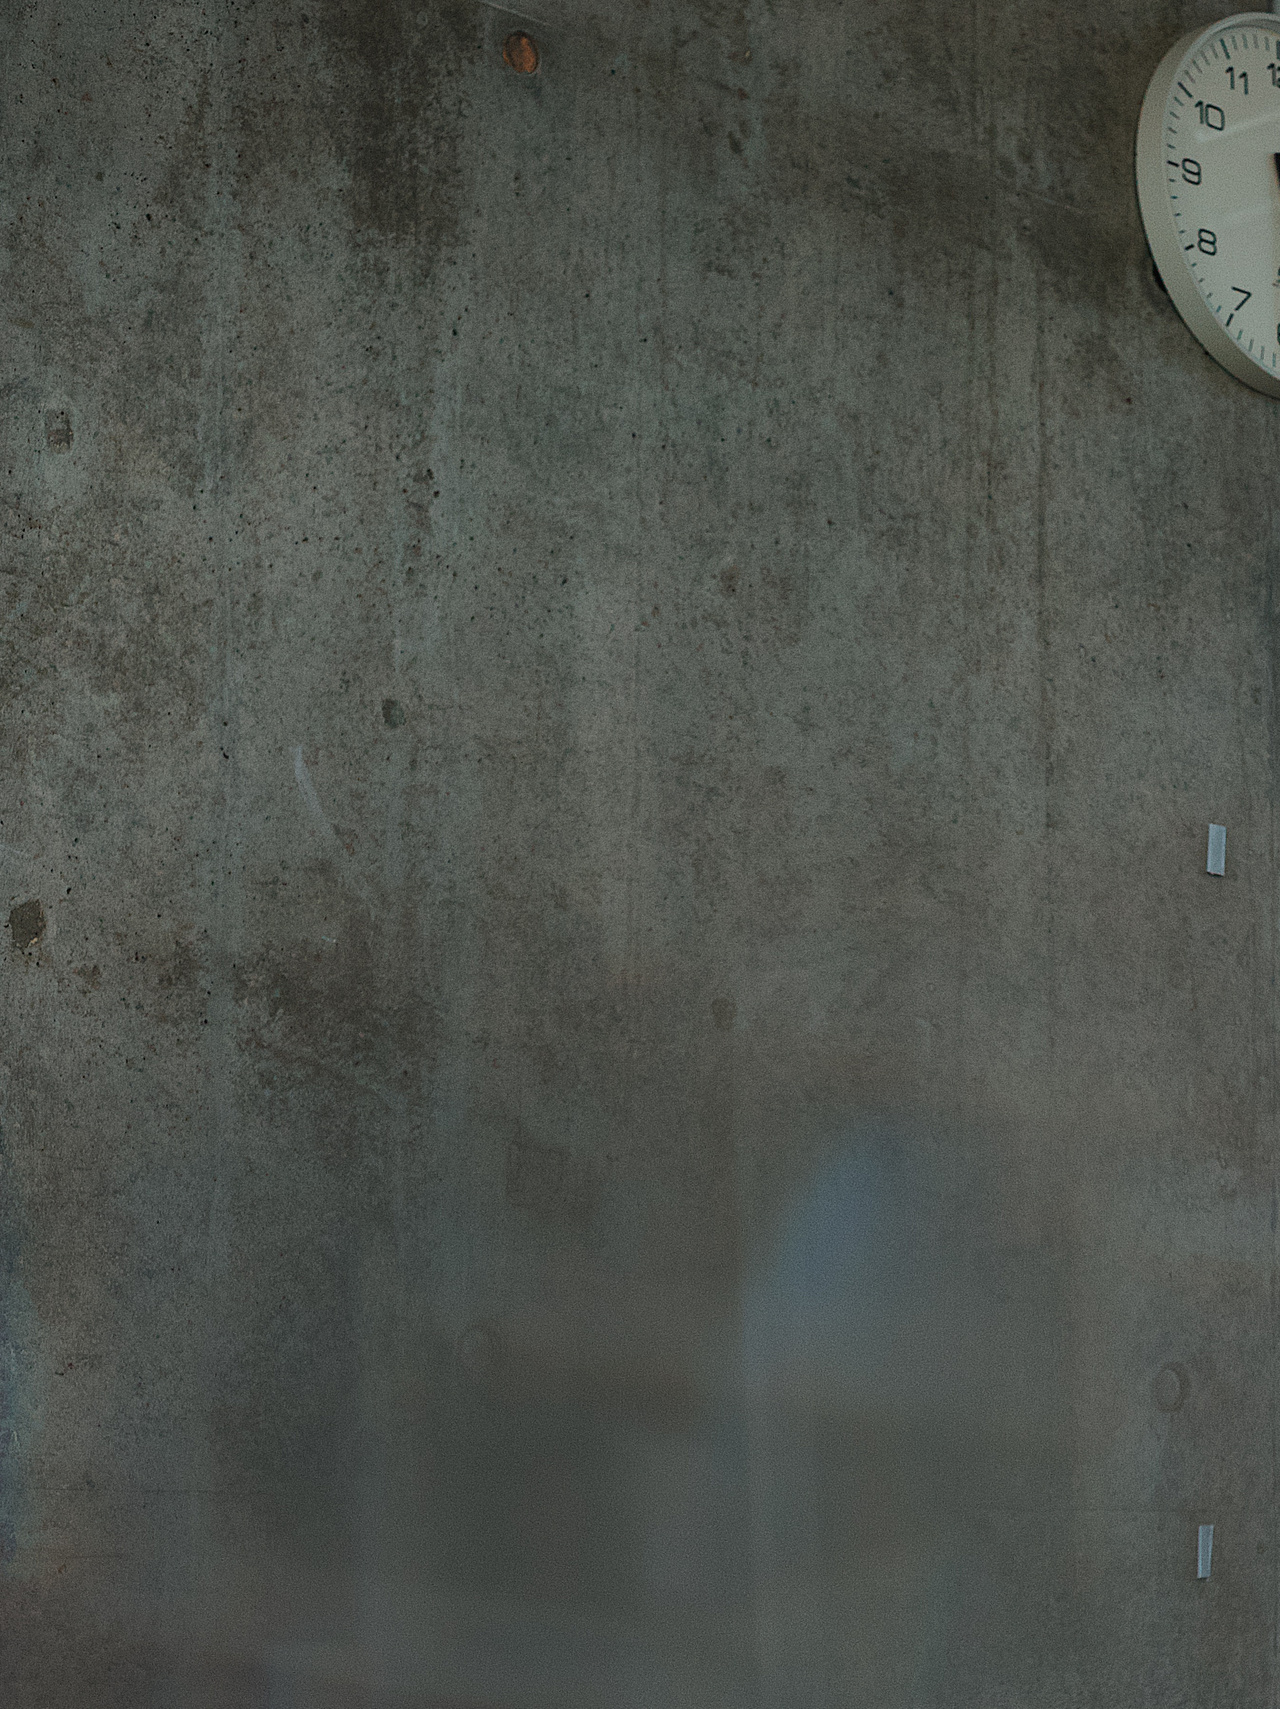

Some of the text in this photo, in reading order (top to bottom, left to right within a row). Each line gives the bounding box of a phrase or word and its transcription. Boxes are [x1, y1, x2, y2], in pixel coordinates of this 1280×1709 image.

[1225, 66, 1249, 95] 11
[1194, 100, 1225, 131] 10
[1181, 158, 1202, 186] 9
[1198, 228, 1218, 256] 8
[1231, 286, 1252, 311] 7
